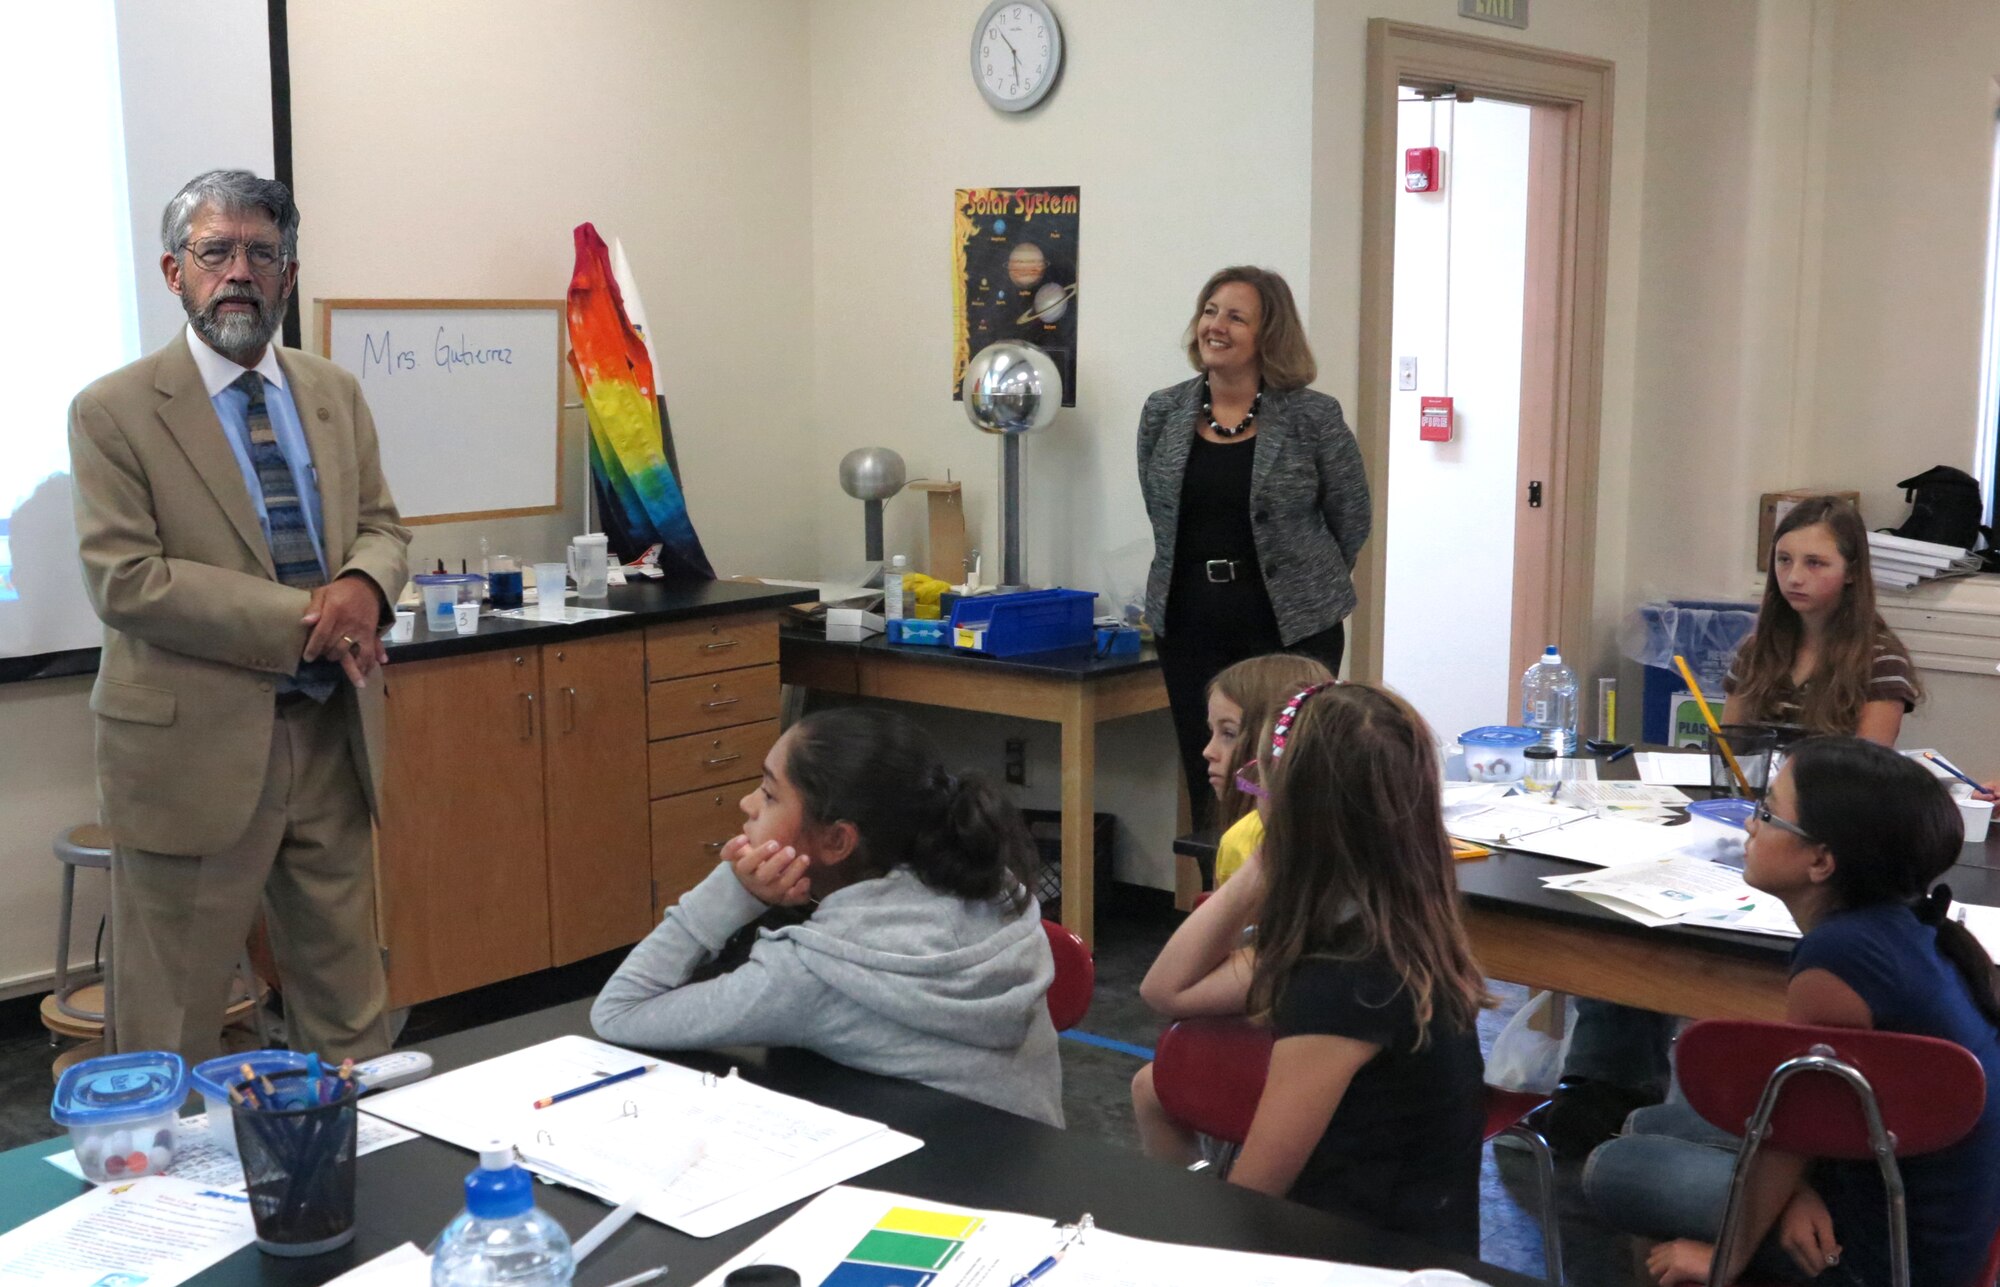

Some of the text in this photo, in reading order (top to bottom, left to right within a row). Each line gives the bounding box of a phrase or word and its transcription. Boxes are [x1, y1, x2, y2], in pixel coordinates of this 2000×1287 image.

[1000, 14, 1006, 25] 11
[1013, 7, 1022, 20] 12
[989, 28, 998, 40] 10
[1037, 26, 1044, 38] 2
[983, 46, 990, 58] 9
[1040, 45, 1048, 57] 3
[987, 64, 994, 76] 8
[1035, 64, 1042, 74] 4
[998, 78, 1004, 90] 7
[1010, 83, 1017, 95] 6
[1024, 78, 1031, 90] 5
[967, 188, 1078, 222] Solar System
[434, 325, 514, 374] Gutierrez
[1421, 416, 1447, 427] FIRE
[1679, 721, 1707, 735] PLAS
